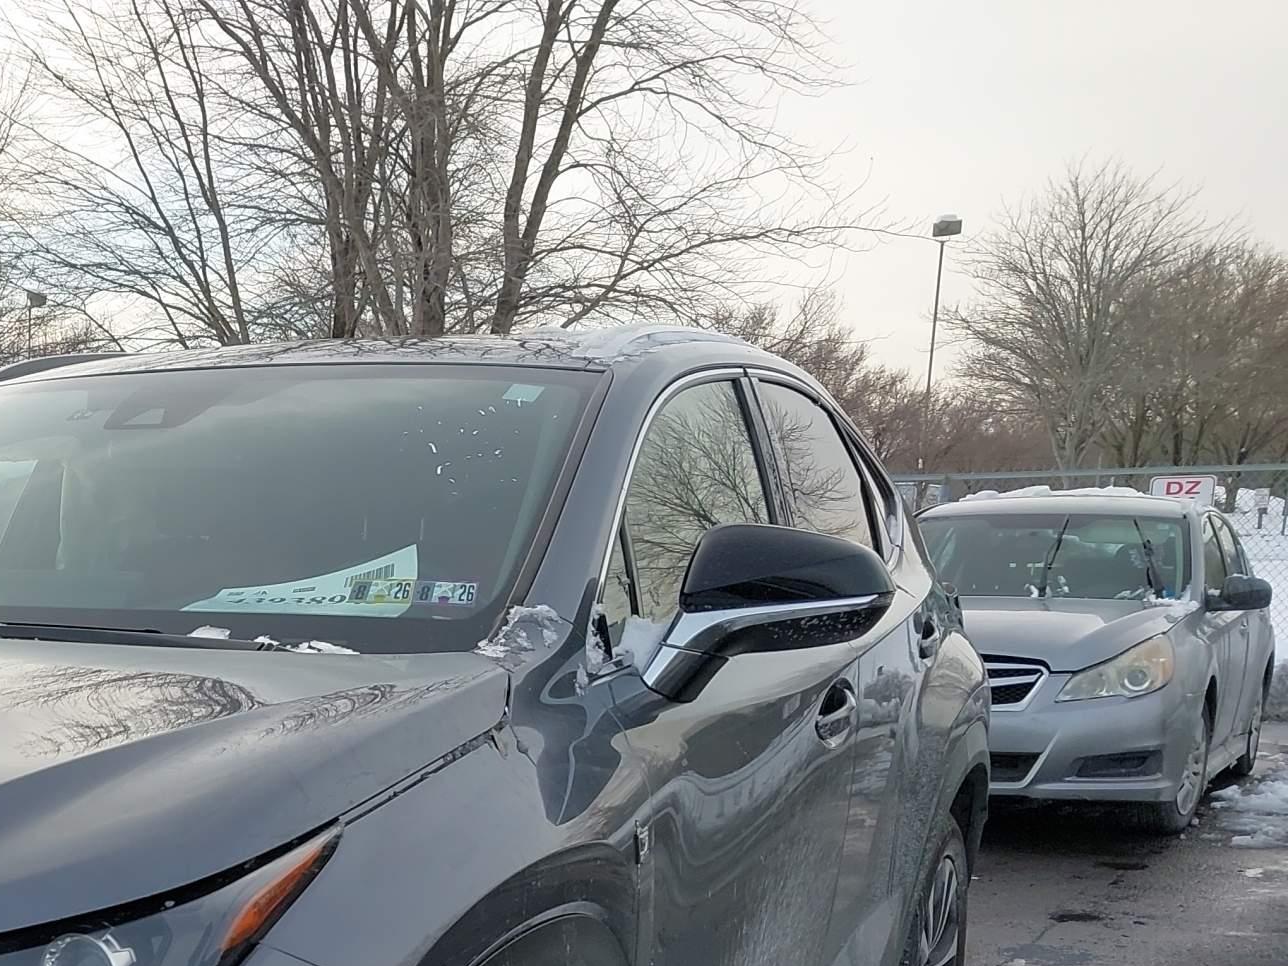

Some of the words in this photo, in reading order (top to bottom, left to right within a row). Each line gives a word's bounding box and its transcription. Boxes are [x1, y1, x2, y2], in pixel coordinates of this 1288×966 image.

[1165, 480, 1202, 496] DZ
[394, 582, 411, 600] 26
[458, 584, 475, 602] 26
